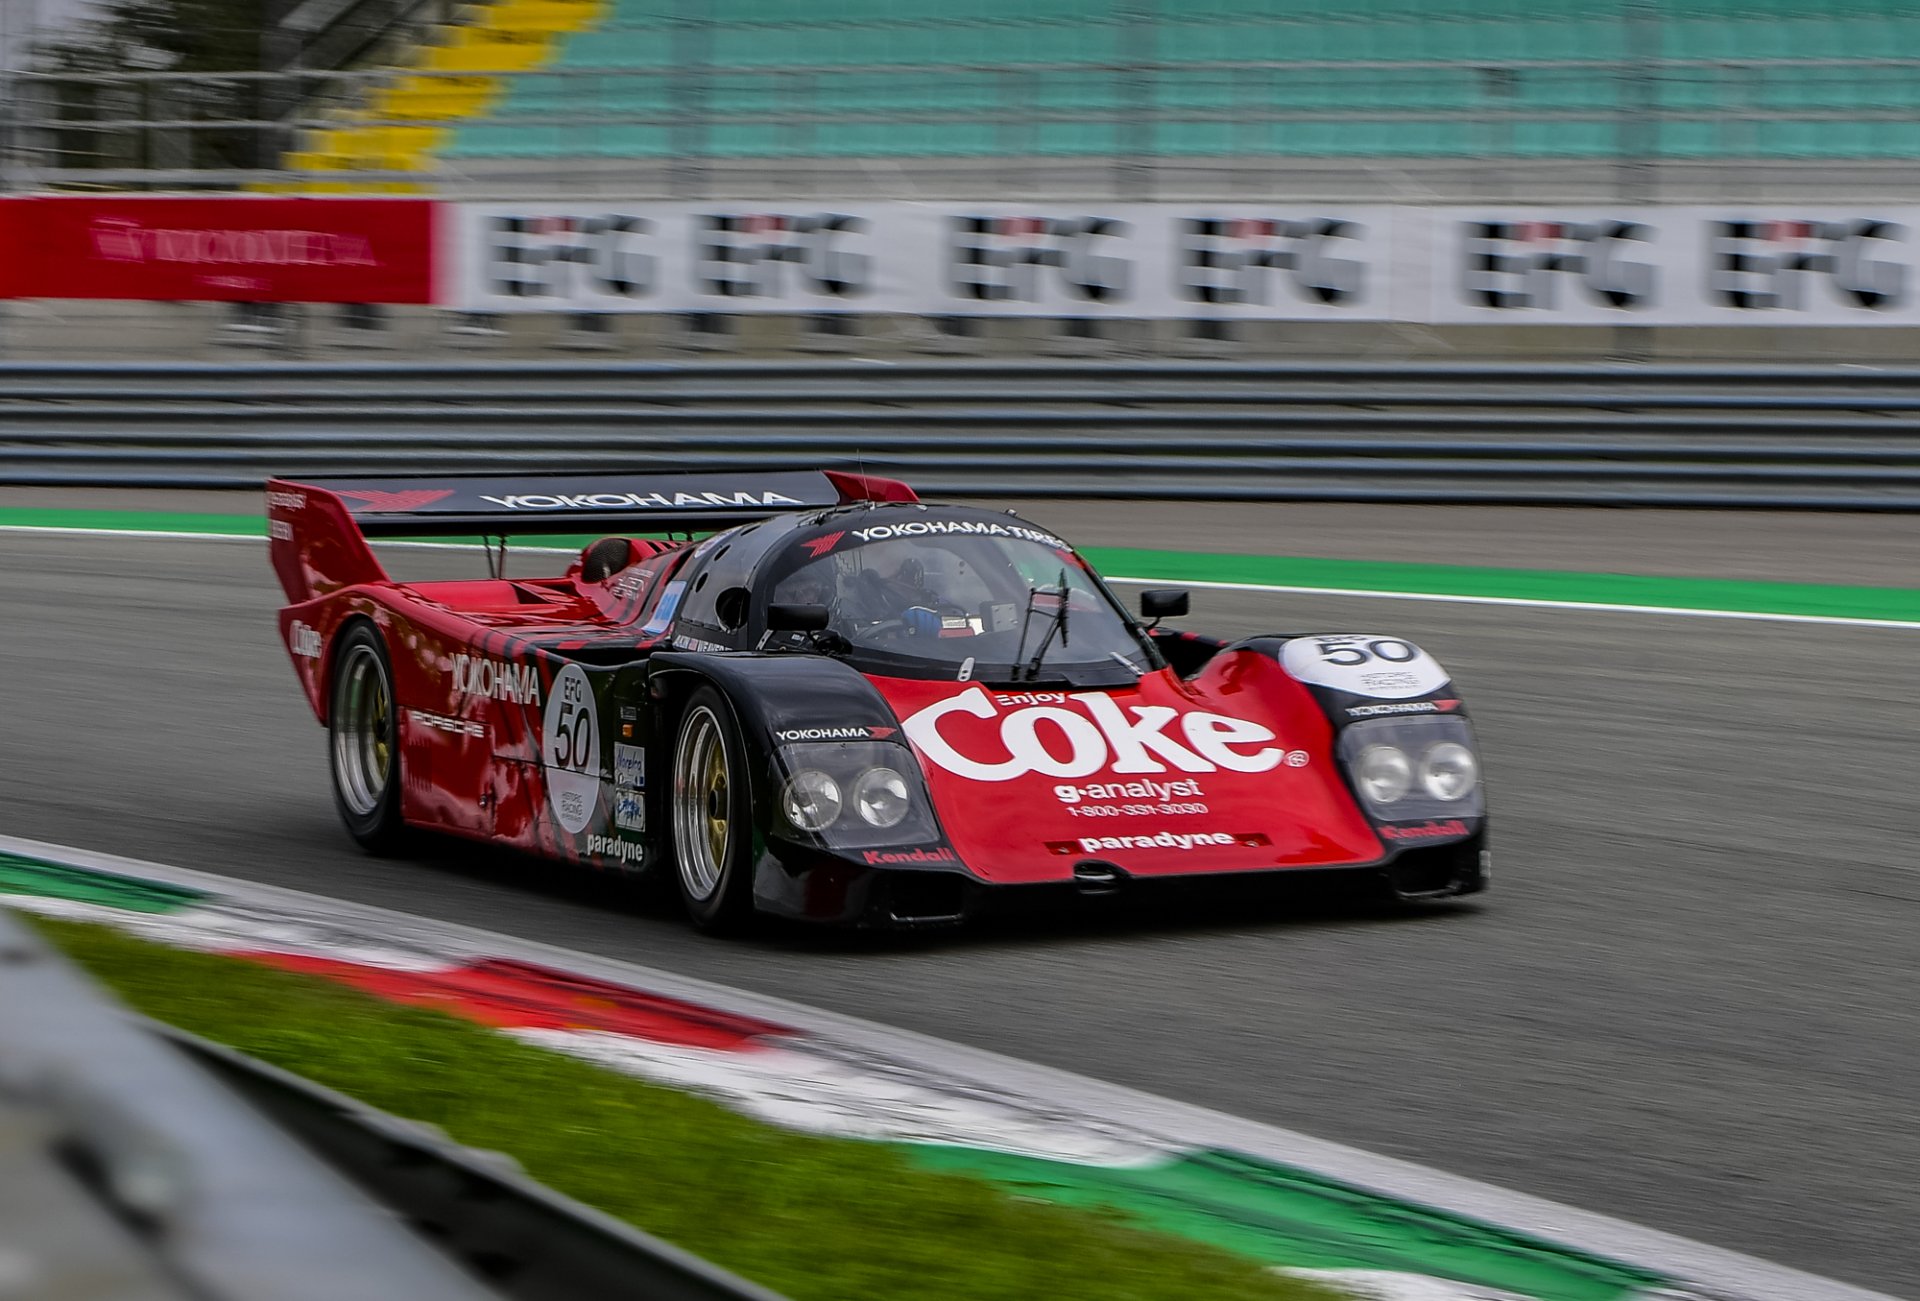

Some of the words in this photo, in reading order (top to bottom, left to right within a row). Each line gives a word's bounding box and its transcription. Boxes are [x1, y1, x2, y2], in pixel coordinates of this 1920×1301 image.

[488, 213, 657, 299] EFG
[694, 213, 872, 299] EFG
[946, 215, 1132, 302] EFG
[1174, 217, 1367, 304] EFG
[1462, 220, 1660, 310] EFG
[1706, 219, 1910, 310] EFG
[480, 491, 804, 508] YOKOHAMA
[852, 521, 1010, 541] YOKOHAMA
[1315, 639, 1418, 666] 50
[449, 652, 541, 707] YOKOHAMA
[564, 676, 582, 703] EFG
[996, 691, 1067, 707] Enjoy
[410, 710, 485, 738] PORSCHE
[554, 701, 591, 774] 50
[775, 727, 869, 741] YOKOHAMA
[901, 687, 1286, 781] Coke
[587, 833, 643, 863] paradyne
[862, 847, 956, 865] Kendall
[1078, 831, 1236, 853] paradyne
